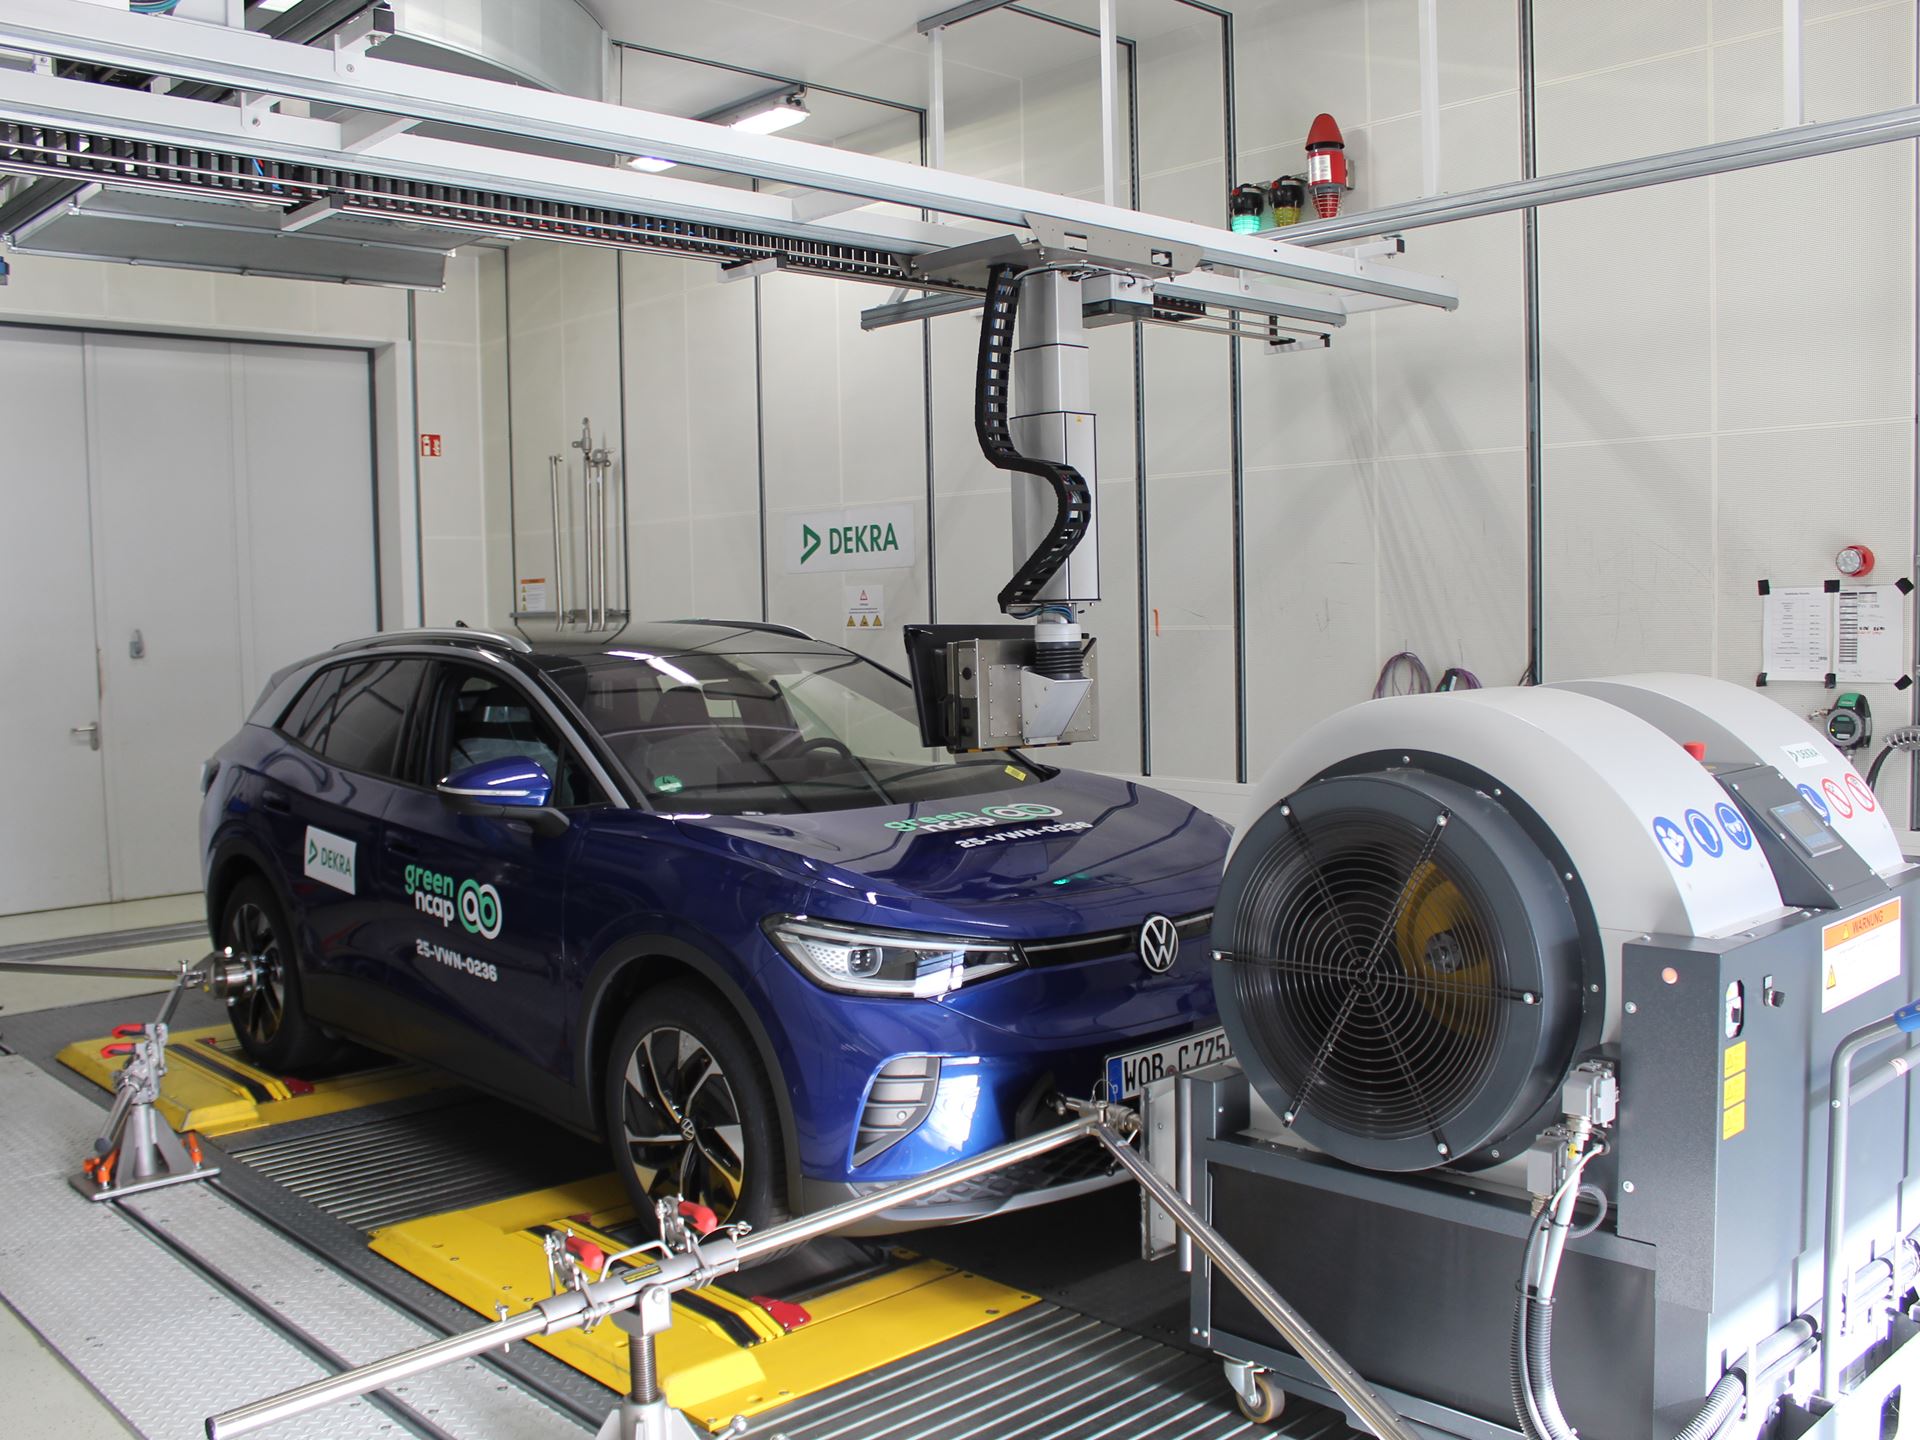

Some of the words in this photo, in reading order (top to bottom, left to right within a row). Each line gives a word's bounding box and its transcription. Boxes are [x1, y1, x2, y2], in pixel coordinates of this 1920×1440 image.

[829, 522, 899, 554] DEKRA
[884, 810, 978, 832] green
[920, 815, 996, 833] ncap
[955, 821, 1094, 848] 25-VWN-0236
[321, 847, 352, 877] DEKRA
[405, 864, 454, 898] green
[415, 890, 455, 927] ncap
[1852, 910, 1884, 933] WARNUNG
[416, 939, 498, 982] 25-VWN-0236
[1124, 1053, 1164, 1092] WOB
[1194, 1033, 1233, 1066] 775
